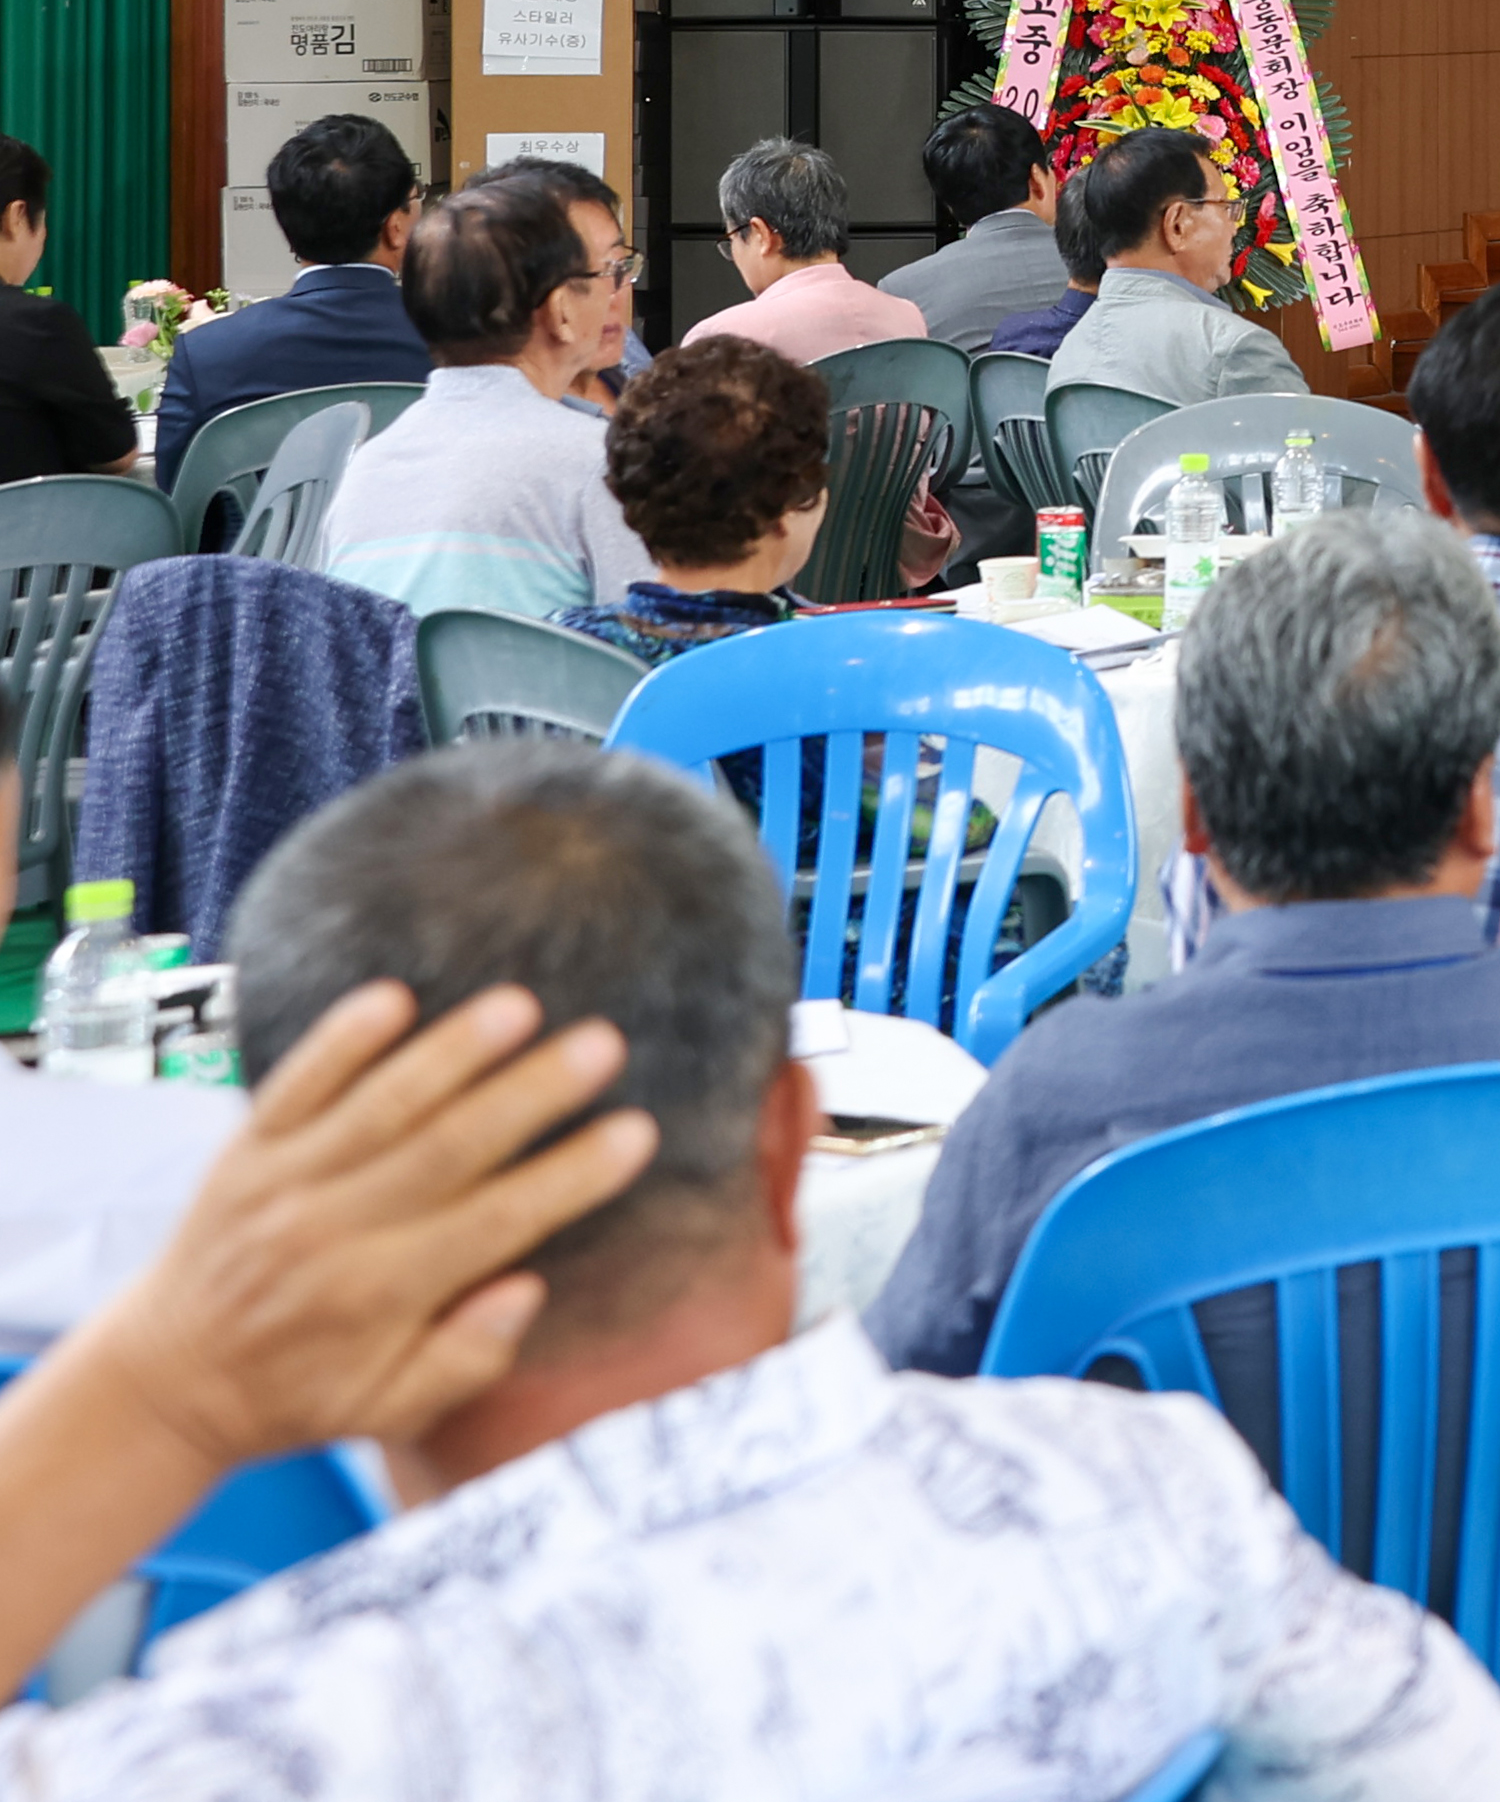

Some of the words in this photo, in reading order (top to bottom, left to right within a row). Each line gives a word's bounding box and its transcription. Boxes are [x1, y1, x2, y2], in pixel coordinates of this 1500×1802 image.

[512, 9, 573, 25] 스타일러
[498, 32, 586, 48] 유사기수(증)
[1006, 85, 1039, 121] 20
[518, 139, 579, 154] 최우수상
[1280, 111, 1324, 182] 이임을
[1301, 193, 1362, 307] 축하합니다
